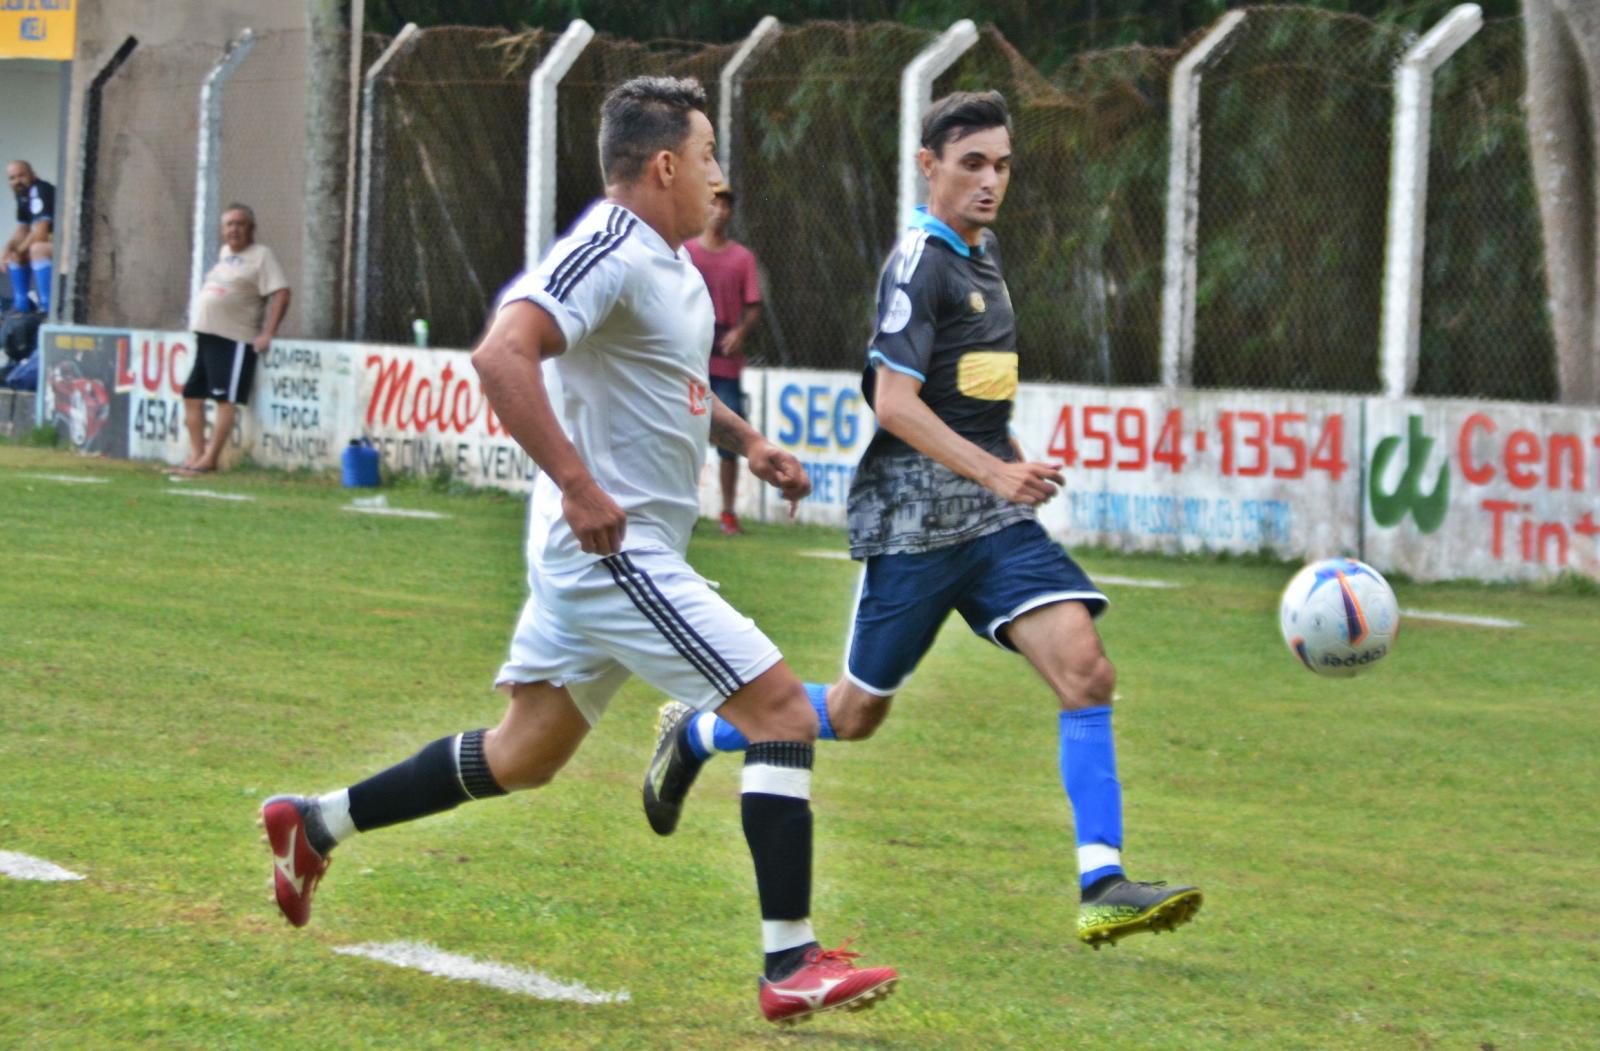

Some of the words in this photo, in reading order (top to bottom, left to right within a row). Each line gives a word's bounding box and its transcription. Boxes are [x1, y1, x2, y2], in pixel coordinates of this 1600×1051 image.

[262, 346, 322, 370] COMPRA
[271, 376, 319, 401] VENDE
[270, 403, 319, 430] TROCA
[778, 383, 879, 450] SEG
[1458, 412, 1600, 492] Cen
